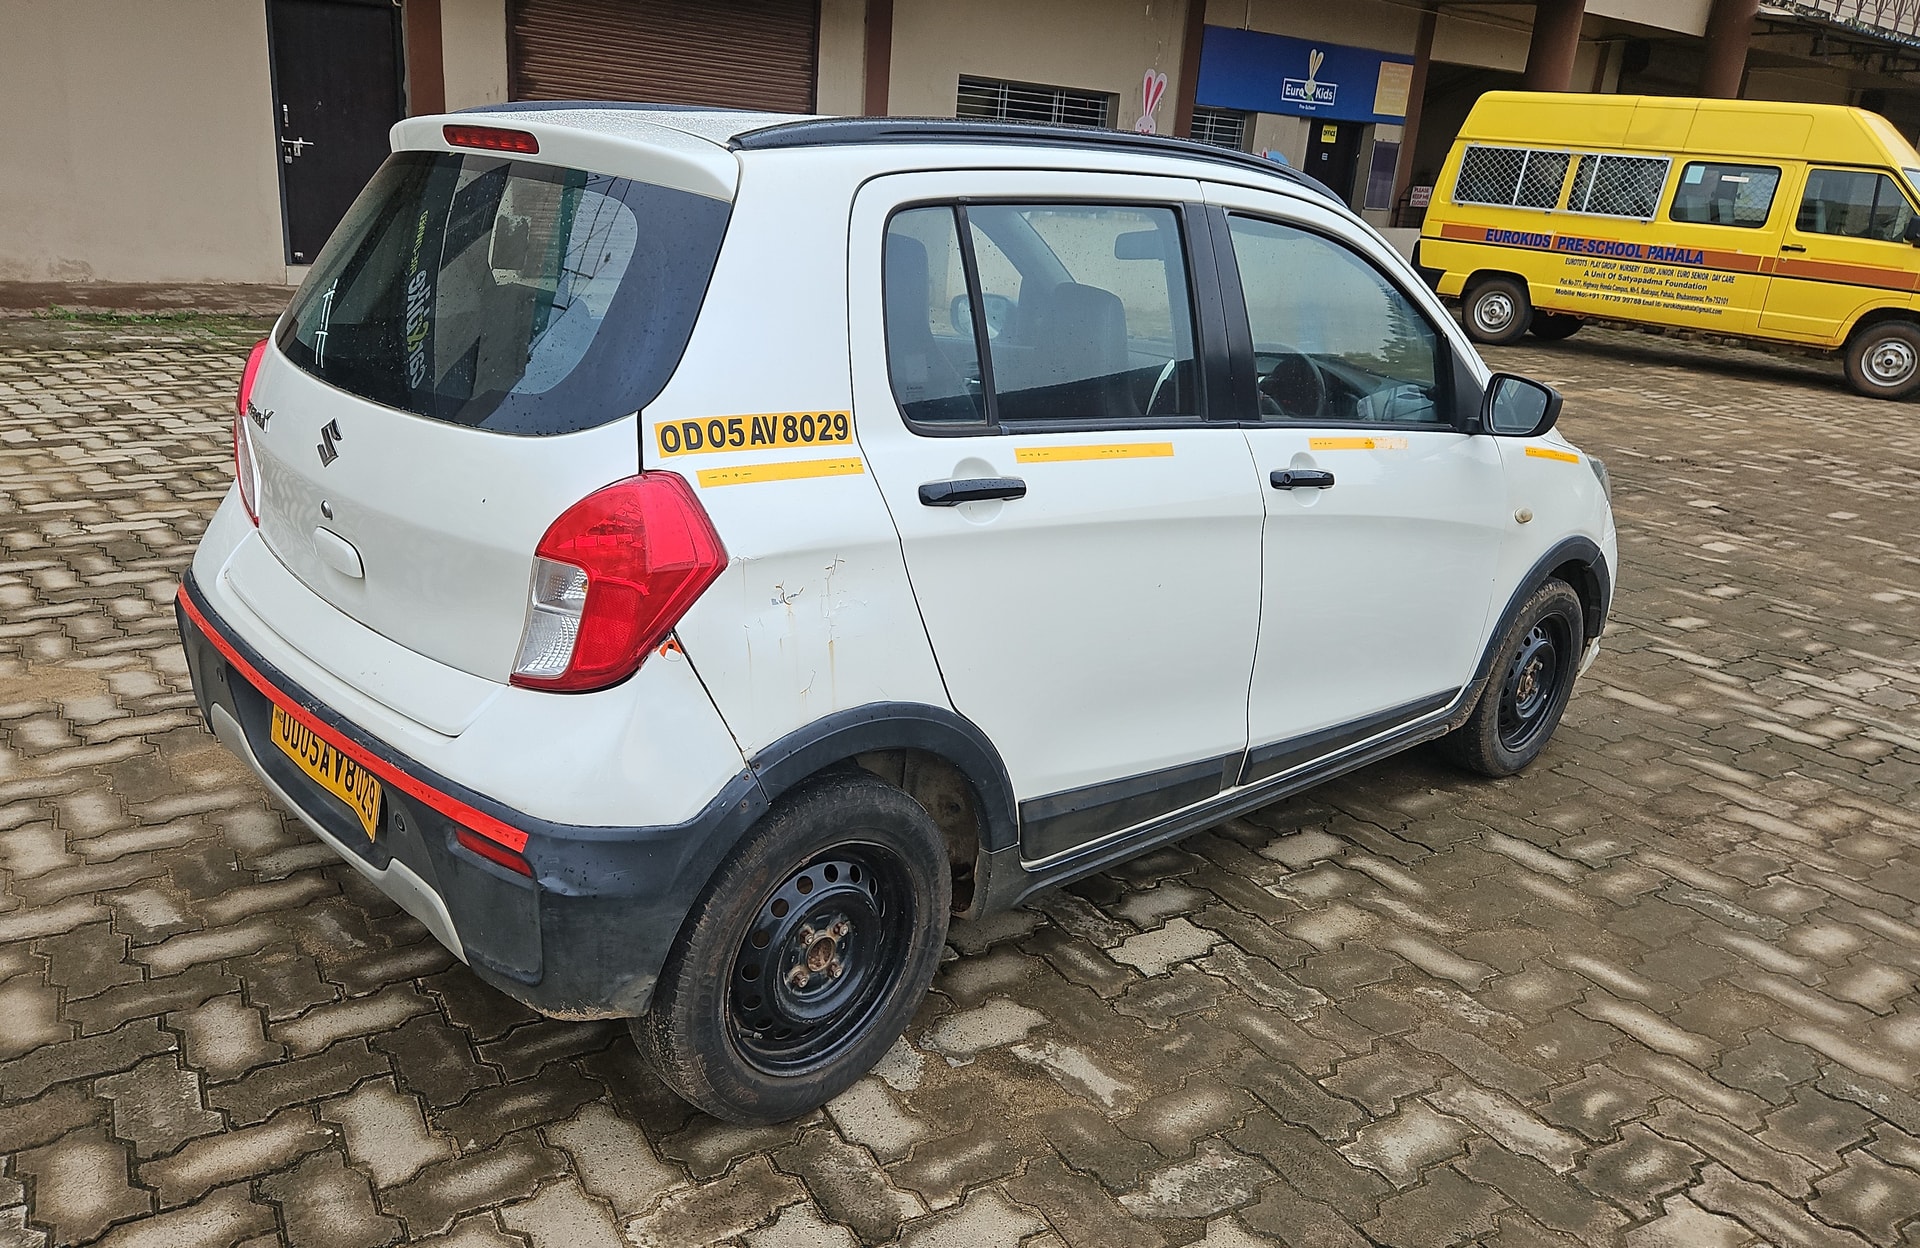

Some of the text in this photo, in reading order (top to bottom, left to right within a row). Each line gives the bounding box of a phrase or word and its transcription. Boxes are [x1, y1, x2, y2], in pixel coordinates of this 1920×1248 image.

[1486, 229, 1704, 265] EUROKIDS PRE-SCHOOL PAHALA
[1591, 271, 1606, 279] Unit
[1618, 274, 1663, 286] Satyapadma
[1665, 279, 1708, 290] Foundation
[1619, 264, 1640, 272] NURSERY
[1643, 266, 1656, 274] EURO
[1677, 270, 1690, 278] EURO
[1691, 272, 1709, 281] SENIOR
[1721, 275, 1735, 283] CARE
[1555, 288, 1575, 296] Mobile
